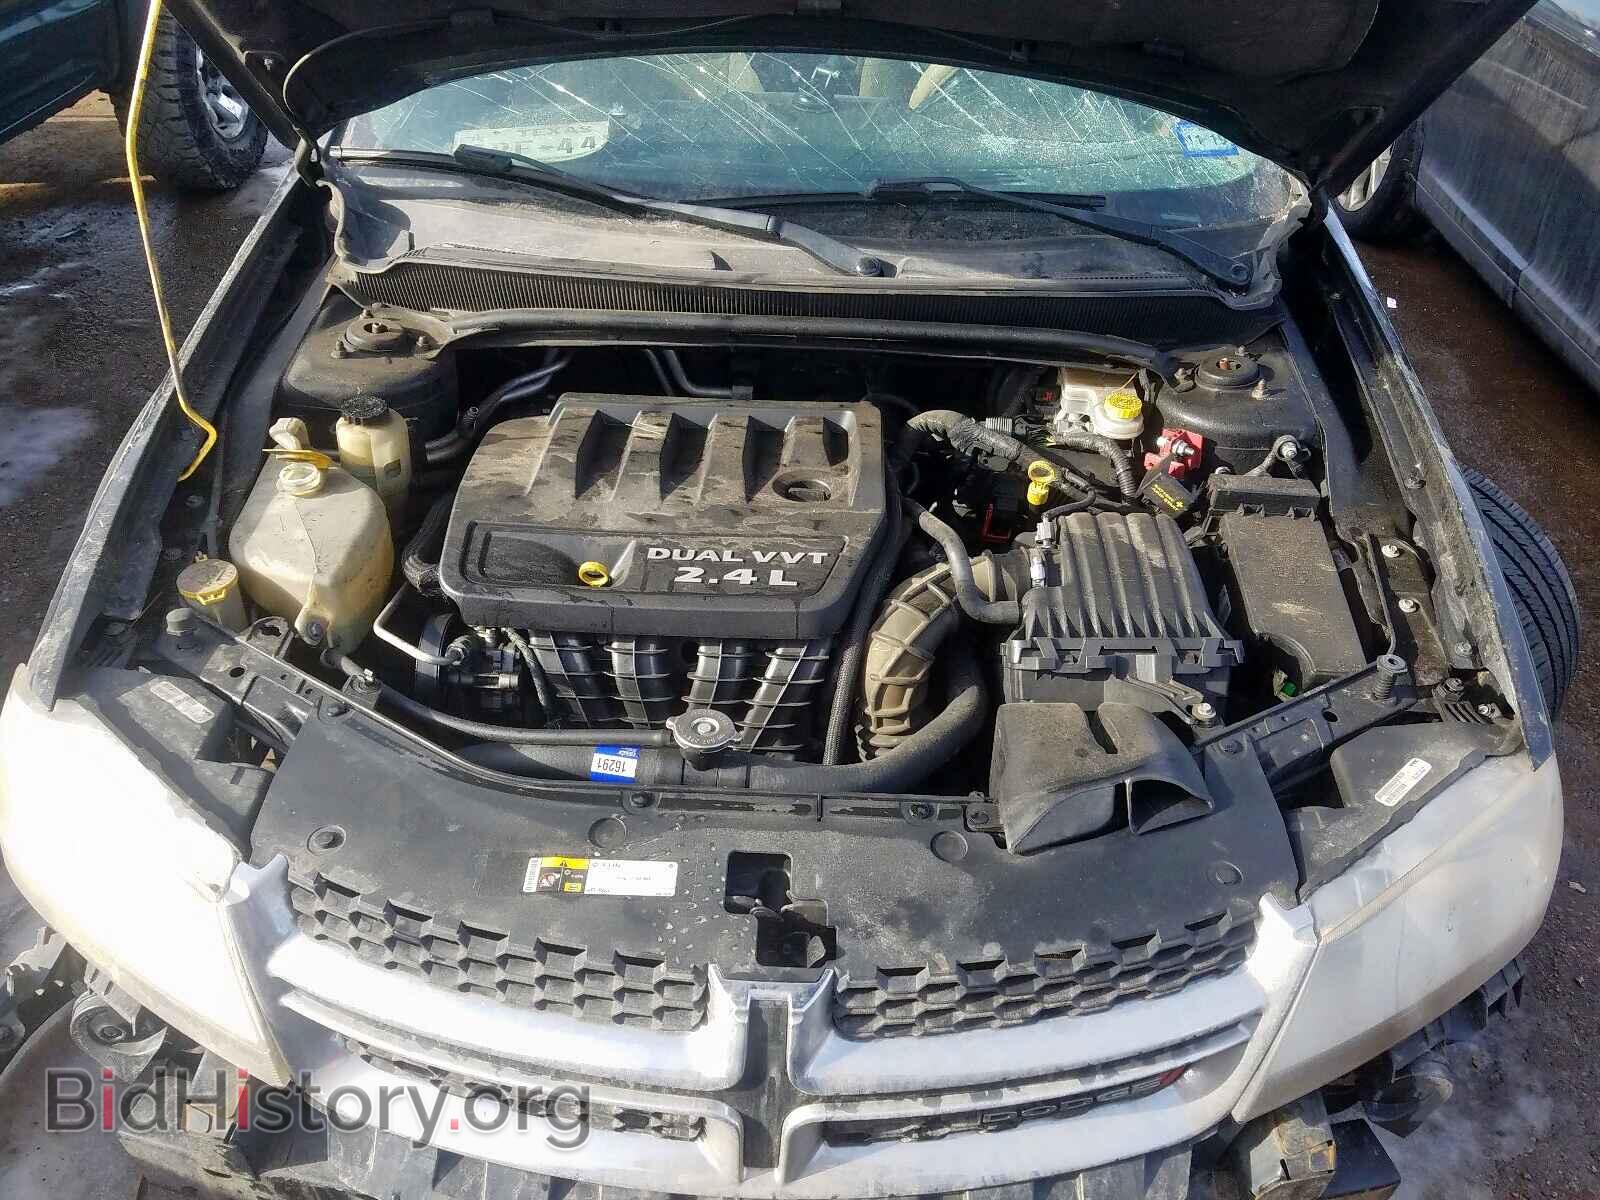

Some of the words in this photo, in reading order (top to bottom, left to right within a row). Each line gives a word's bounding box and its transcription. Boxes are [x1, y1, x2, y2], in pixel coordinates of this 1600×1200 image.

[647, 547, 744, 562] DUAL
[751, 550, 829, 564] VVT
[674, 566, 758, 585] 2.4
[596, 757, 626, 773] 16291
